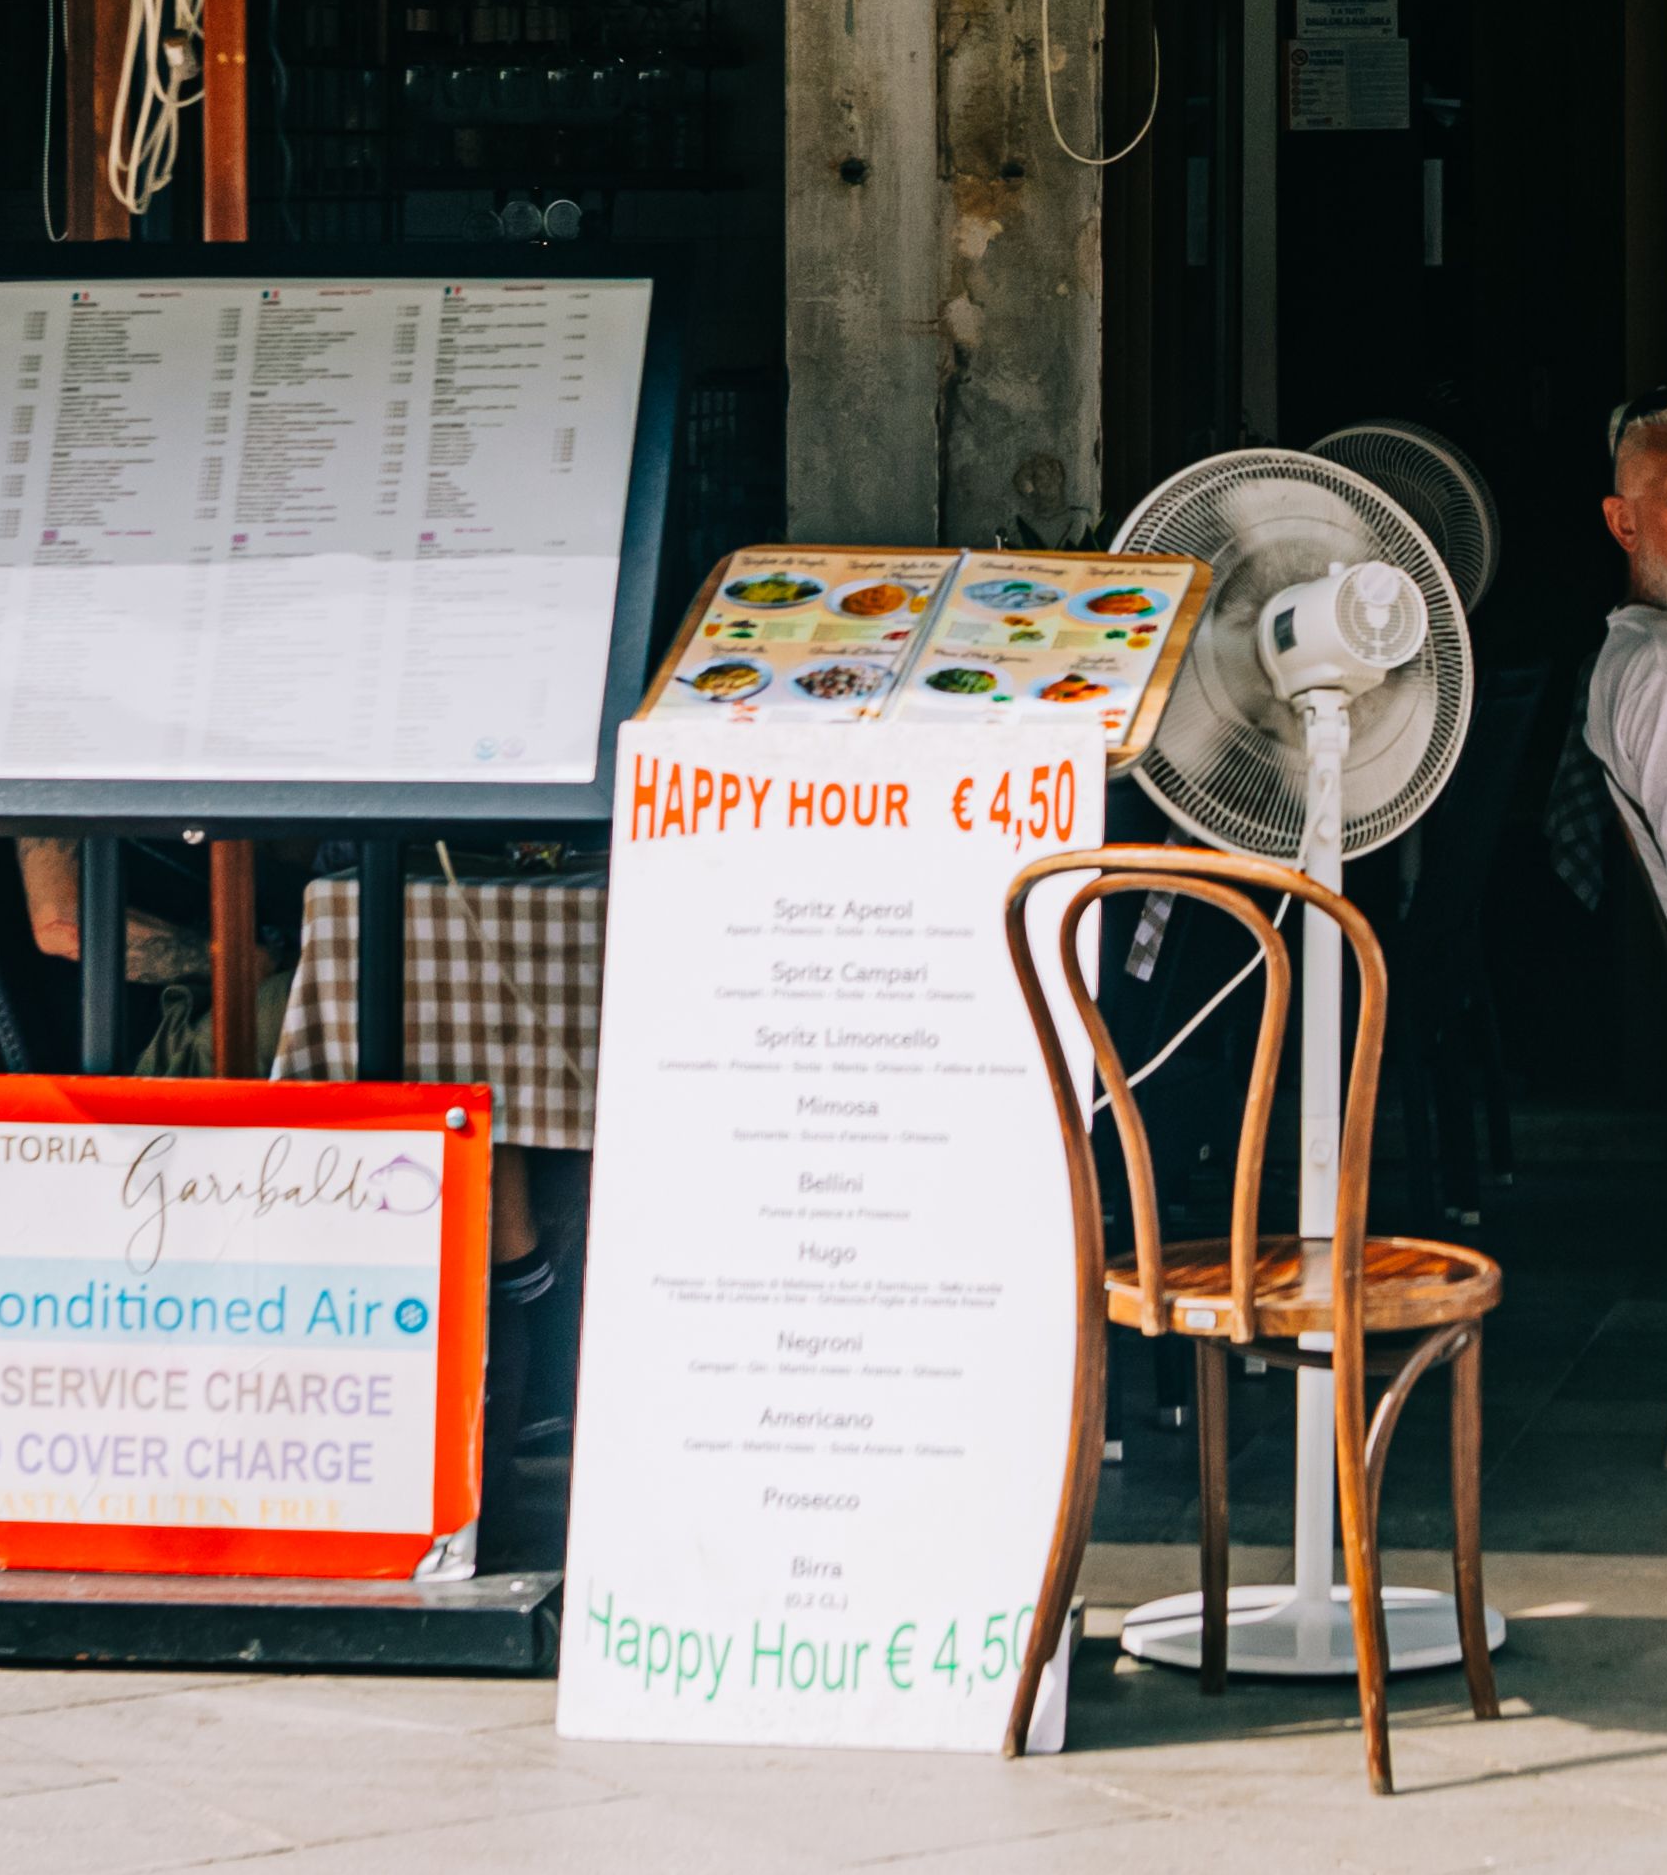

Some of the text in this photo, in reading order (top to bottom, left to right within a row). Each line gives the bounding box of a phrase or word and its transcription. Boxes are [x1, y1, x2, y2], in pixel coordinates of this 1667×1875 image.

[632, 755, 1076, 852] HAPPY HOUR € 4,50
[774, 898, 913, 922] Spritz Aperol
[772, 961, 927, 986] Spritz Campari
[756, 1027, 940, 1050] Spritz Limoncello
[797, 1096, 879, 1116] Mimosa
[799, 1172, 863, 1193] Bellini
[121, 1132, 374, 1276] Garibaldi
[799, 1242, 857, 1268] Hugo
[305, 1286, 384, 1336] Air
[778, 1331, 862, 1357] Negroni
[0, 1366, 187, 1410] SERVICE
[206, 1372, 393, 1416] CHARGE
[759, 1407, 873, 1429] Americano
[16, 1434, 168, 1479] COVER
[185, 1439, 374, 1484] CHARGE
[97, 1492, 239, 1521] GLUTEN
[259, 1498, 343, 1524] FREE
[763, 1487, 860, 1511] Prosecco
[791, 1556, 842, 1578] Birra
[584, 1576, 1038, 1702] Happy Hour € 4,50
